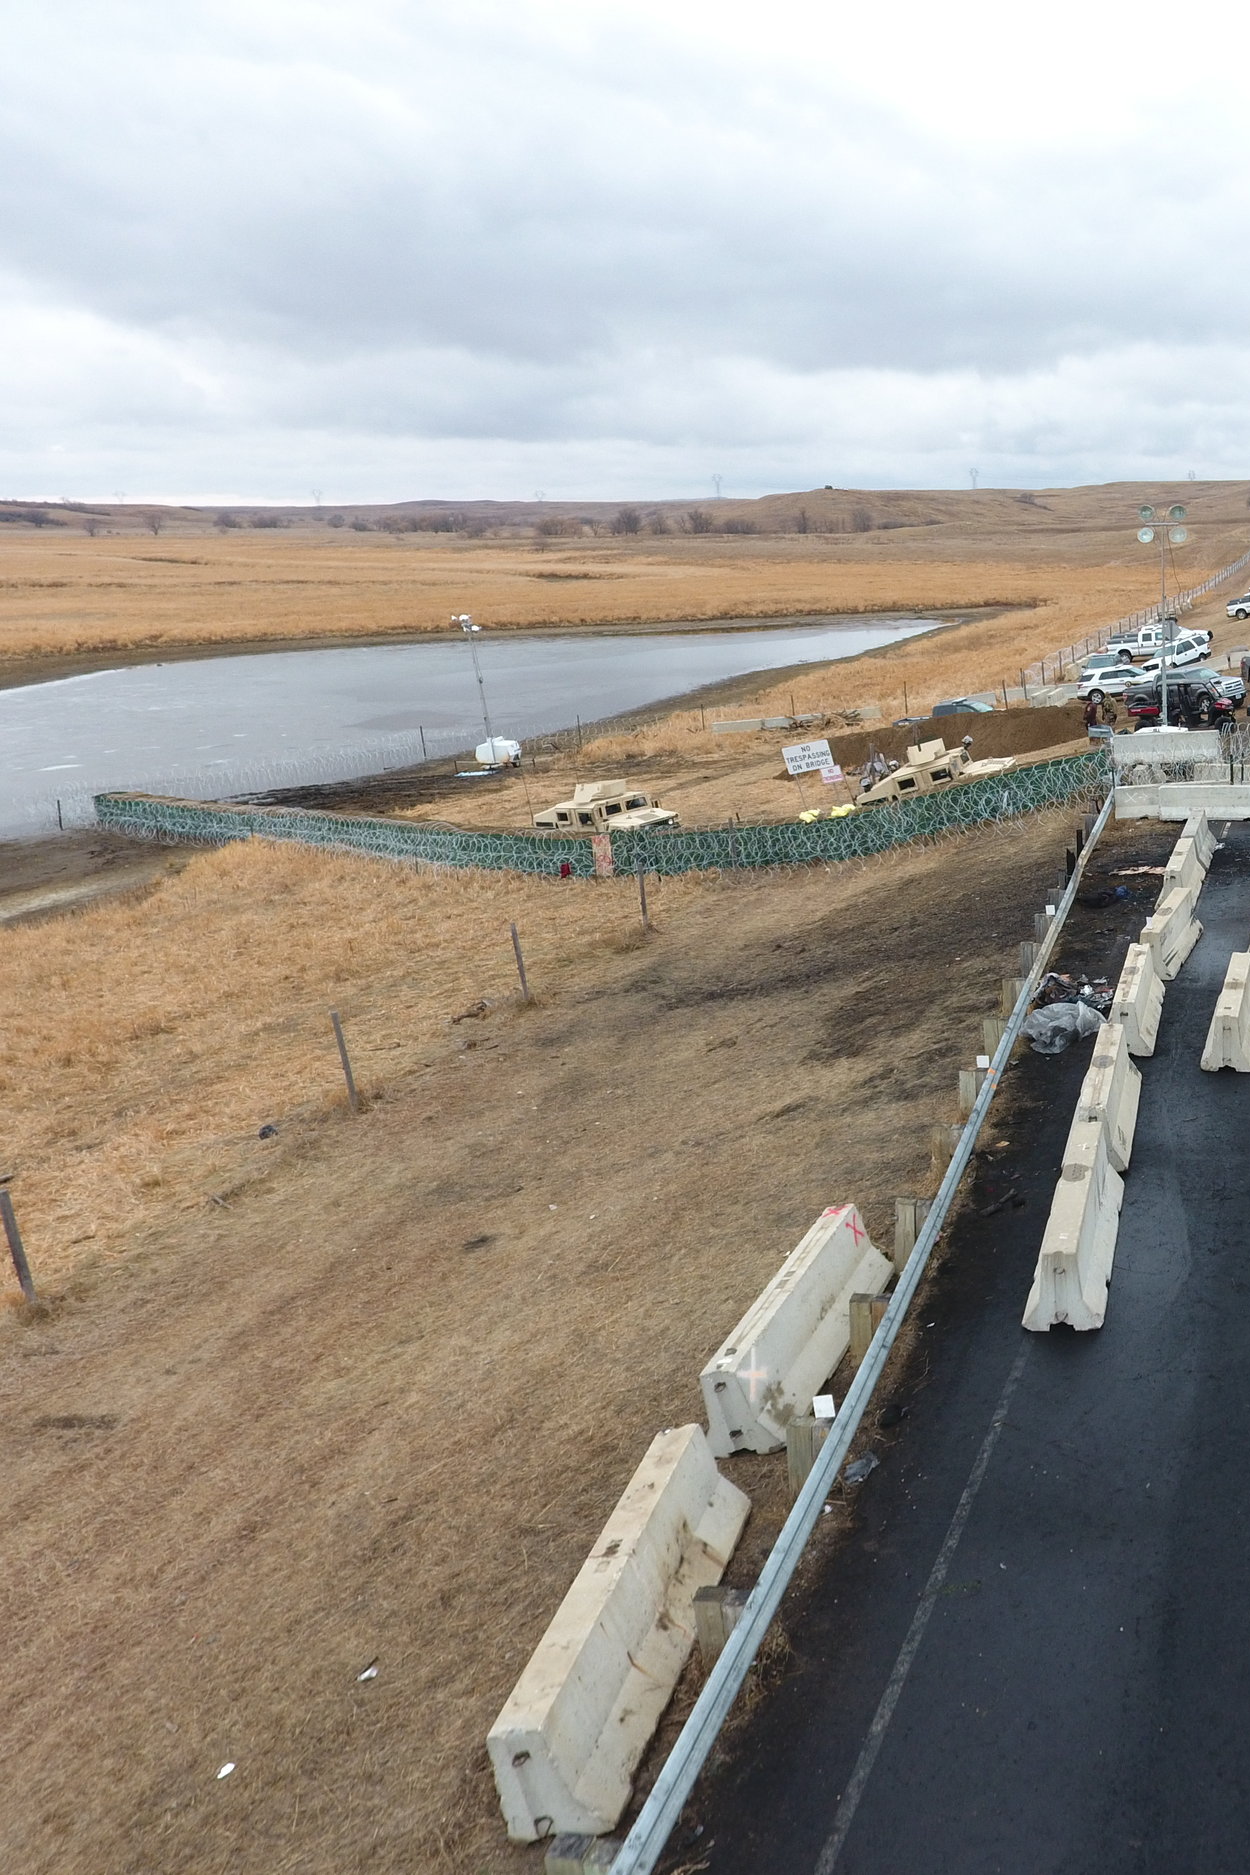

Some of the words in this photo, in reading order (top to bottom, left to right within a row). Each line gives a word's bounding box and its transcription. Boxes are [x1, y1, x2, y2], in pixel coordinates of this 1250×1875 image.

[800, 745, 811, 753] NO
[786, 750, 830, 764] TRESPASSING
[792, 764, 803, 772] ON
[806, 758, 830, 769] BRIDGE
